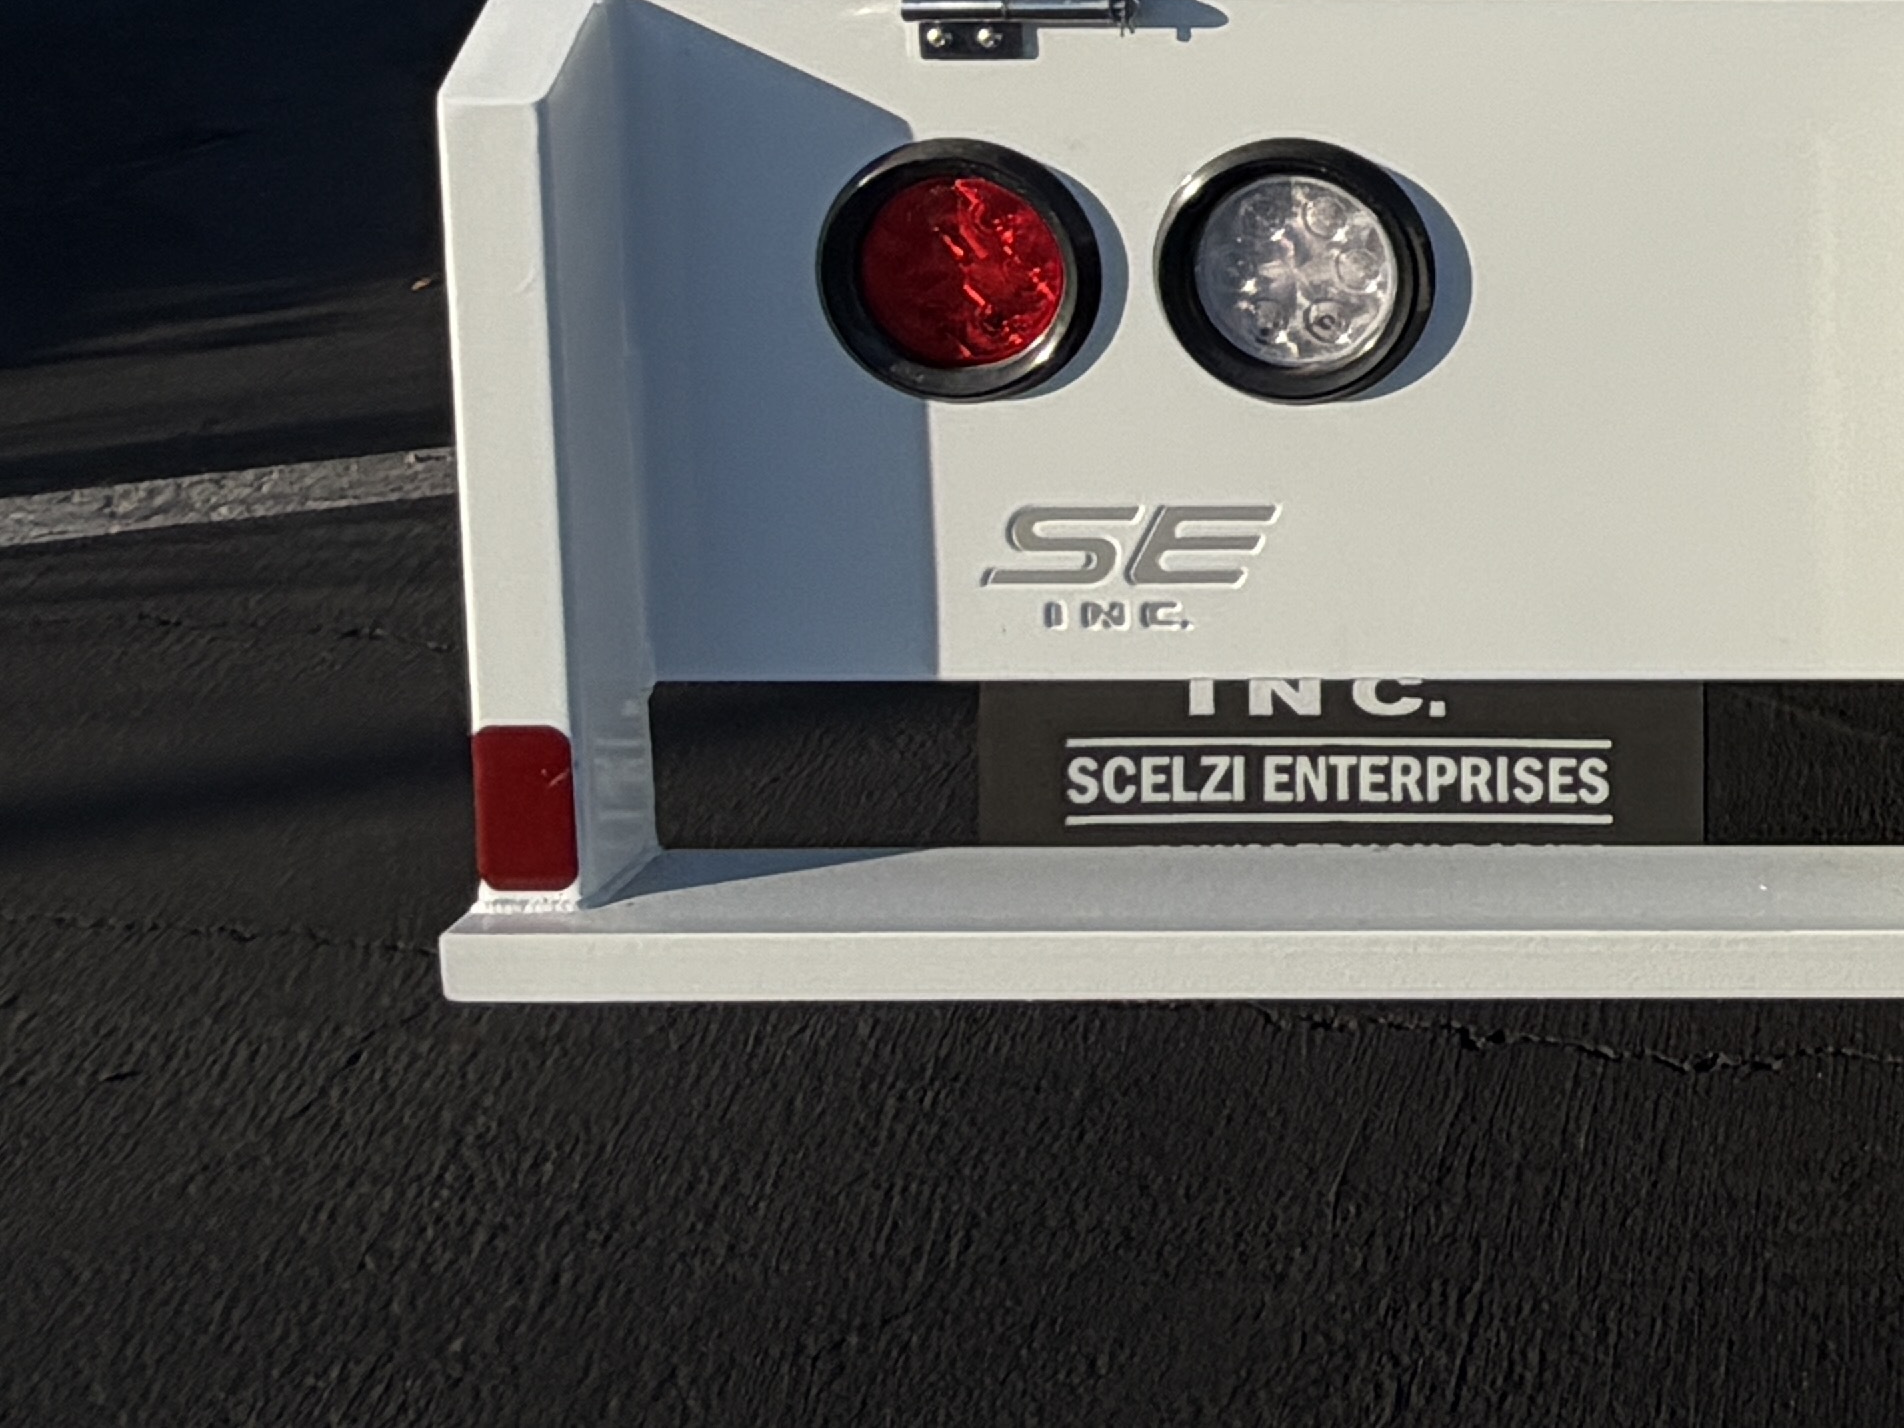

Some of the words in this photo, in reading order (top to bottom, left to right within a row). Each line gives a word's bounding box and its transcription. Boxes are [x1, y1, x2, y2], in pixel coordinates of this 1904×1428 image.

[1042, 600, 1195, 630] INC.
[1065, 755, 1246, 804] SCELZI
[1262, 755, 1610, 805] ENTERPRISES
